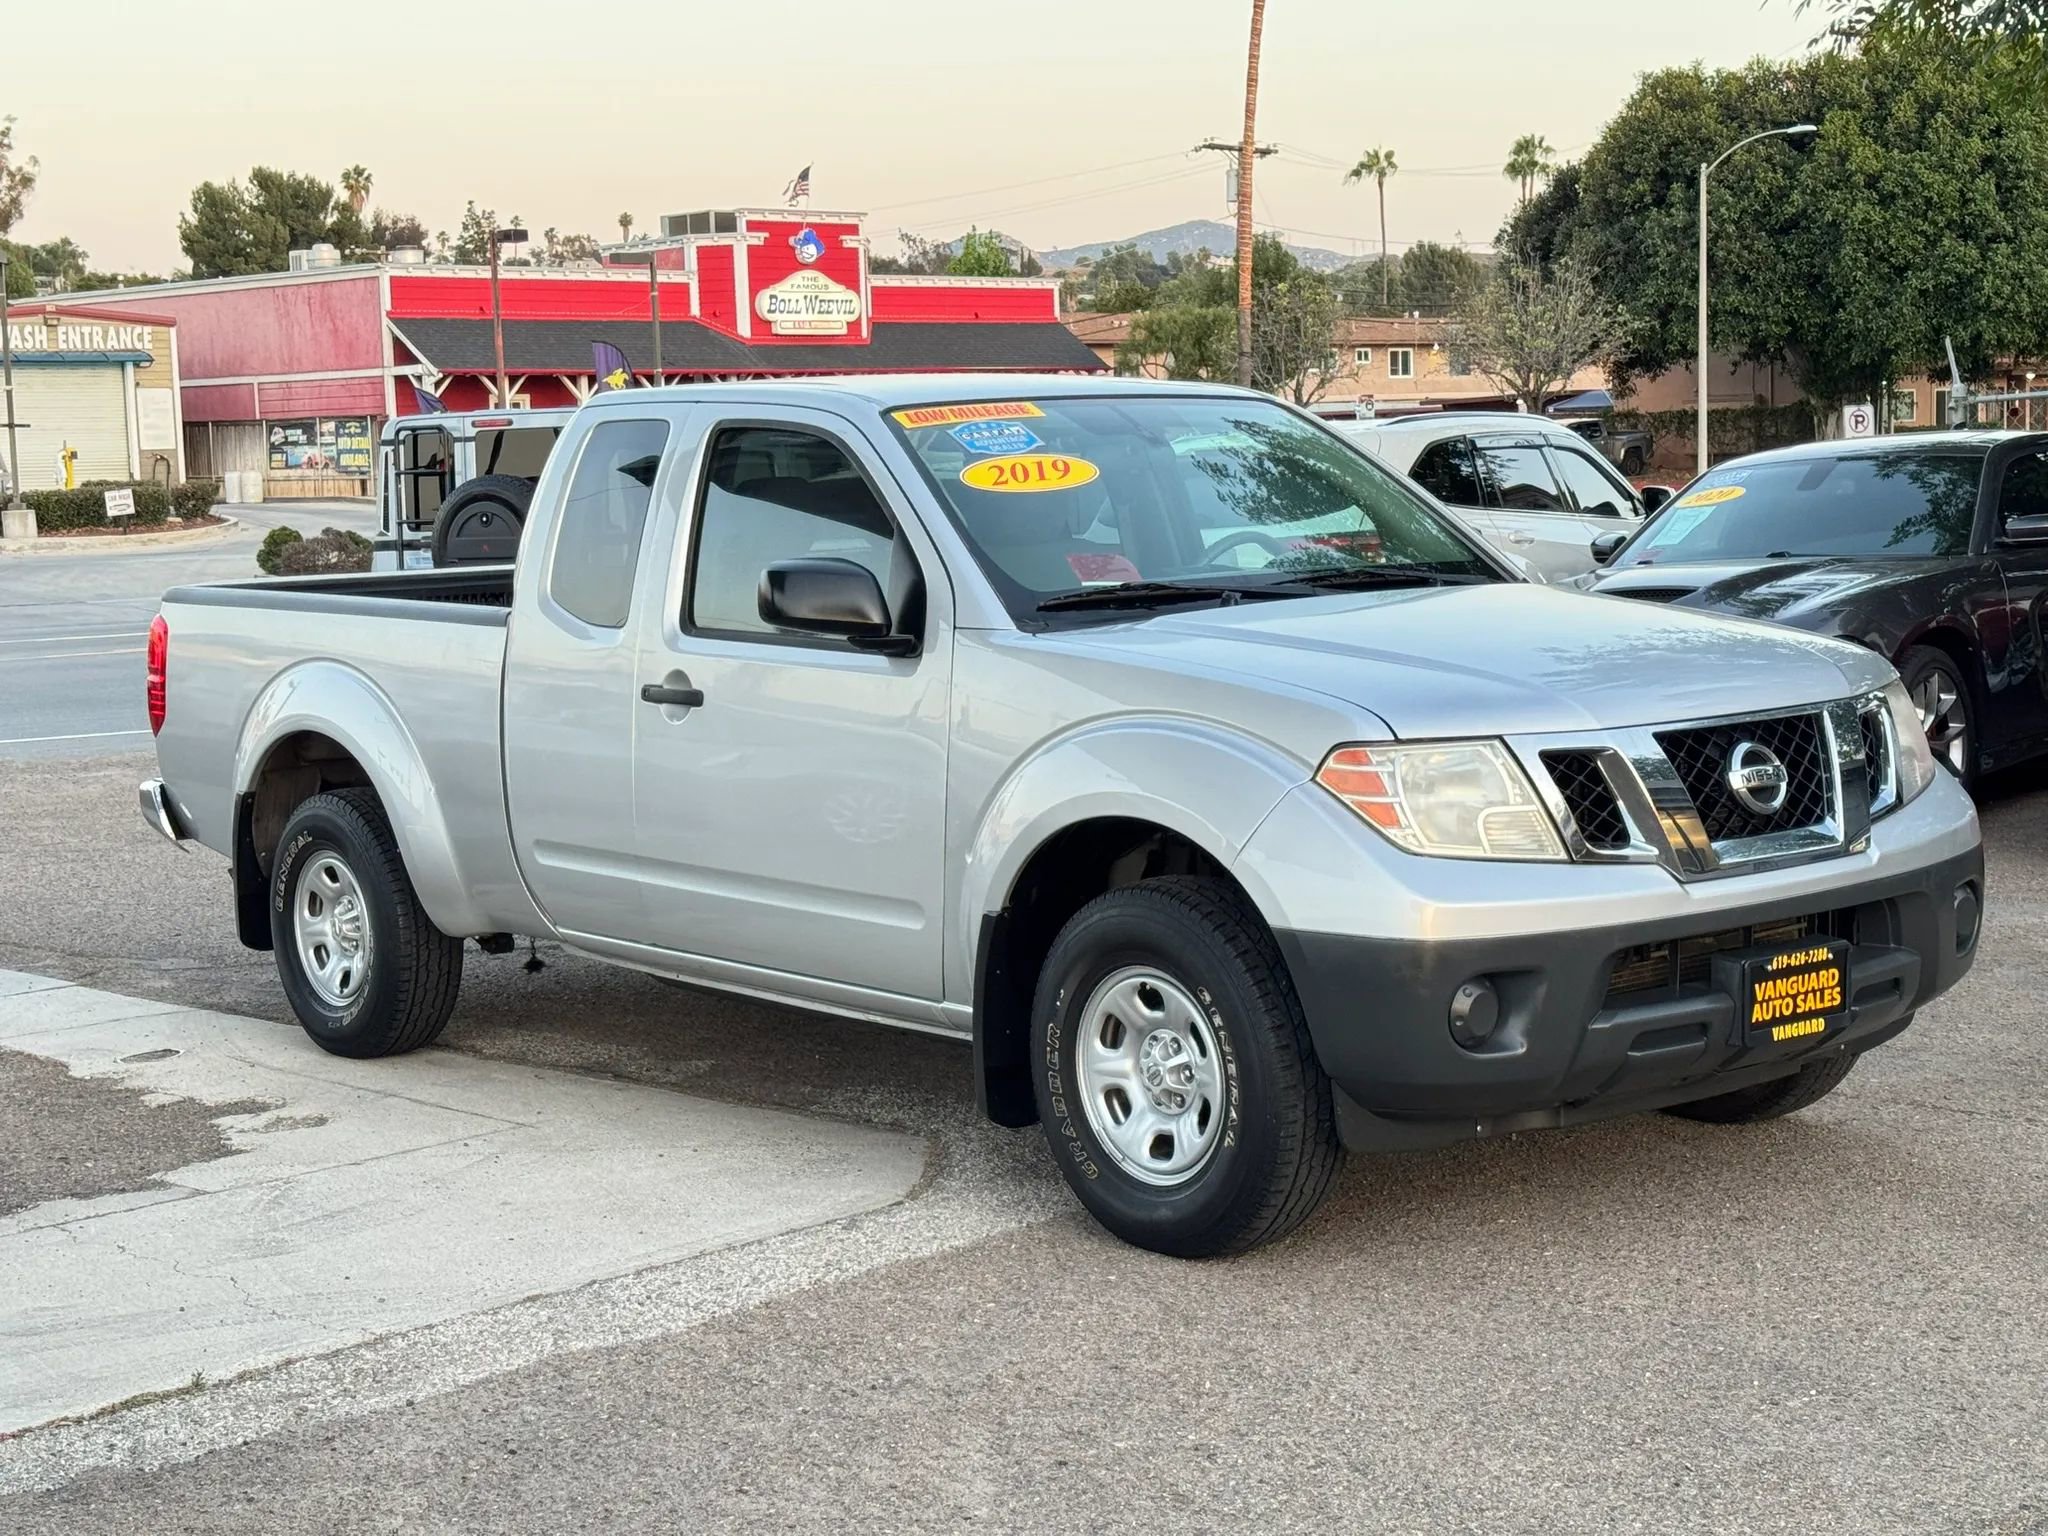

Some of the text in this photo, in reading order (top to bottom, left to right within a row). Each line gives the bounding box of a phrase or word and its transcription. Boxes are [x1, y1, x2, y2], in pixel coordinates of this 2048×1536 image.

[790, 283, 830, 291] FAMOUS
[767, 294, 856, 315] BOLL WEEVIL
[57, 325, 153, 350] ENTRANCE
[903, 403, 1032, 425] LOW MILEAGE
[960, 426, 1027, 441] CARFAX
[987, 458, 1071, 487] 2019
[1741, 766, 1786, 785] NISSAN
[275, 830, 313, 912] GENERAL
[1772, 947, 1828, 970] 619-626-7288
[1754, 968, 1840, 1001] VANGUARD
[1751, 987, 1841, 1023] AUTO SALES
[1771, 1017, 1826, 1042] VANGUARD
[1196, 985, 1240, 1149] GENERAL
[1047, 1023, 1099, 1180] GRABBER
